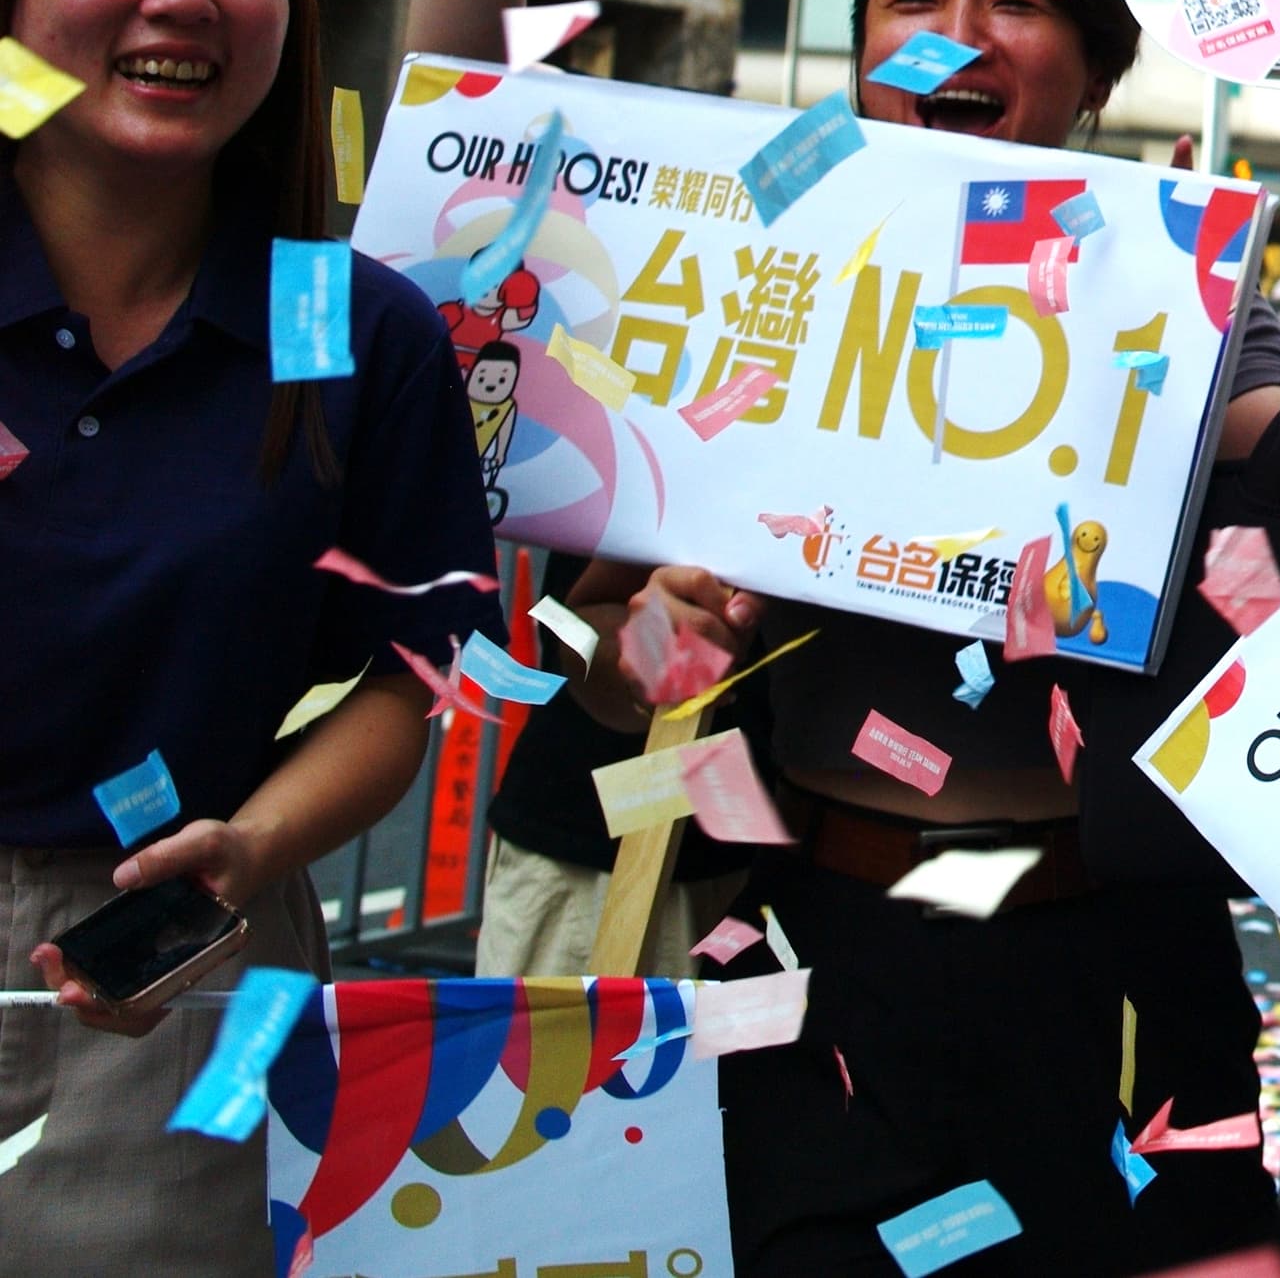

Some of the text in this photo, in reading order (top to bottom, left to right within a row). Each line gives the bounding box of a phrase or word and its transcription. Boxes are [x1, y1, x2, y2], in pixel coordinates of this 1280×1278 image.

[426, 130, 504, 182] OUR
[507, 141, 649, 205] HOES!
[609, 228, 821, 425] 台灣
[889, 585, 938, 604] ASSURANCE
[941, 596, 975, 611] BROKER
